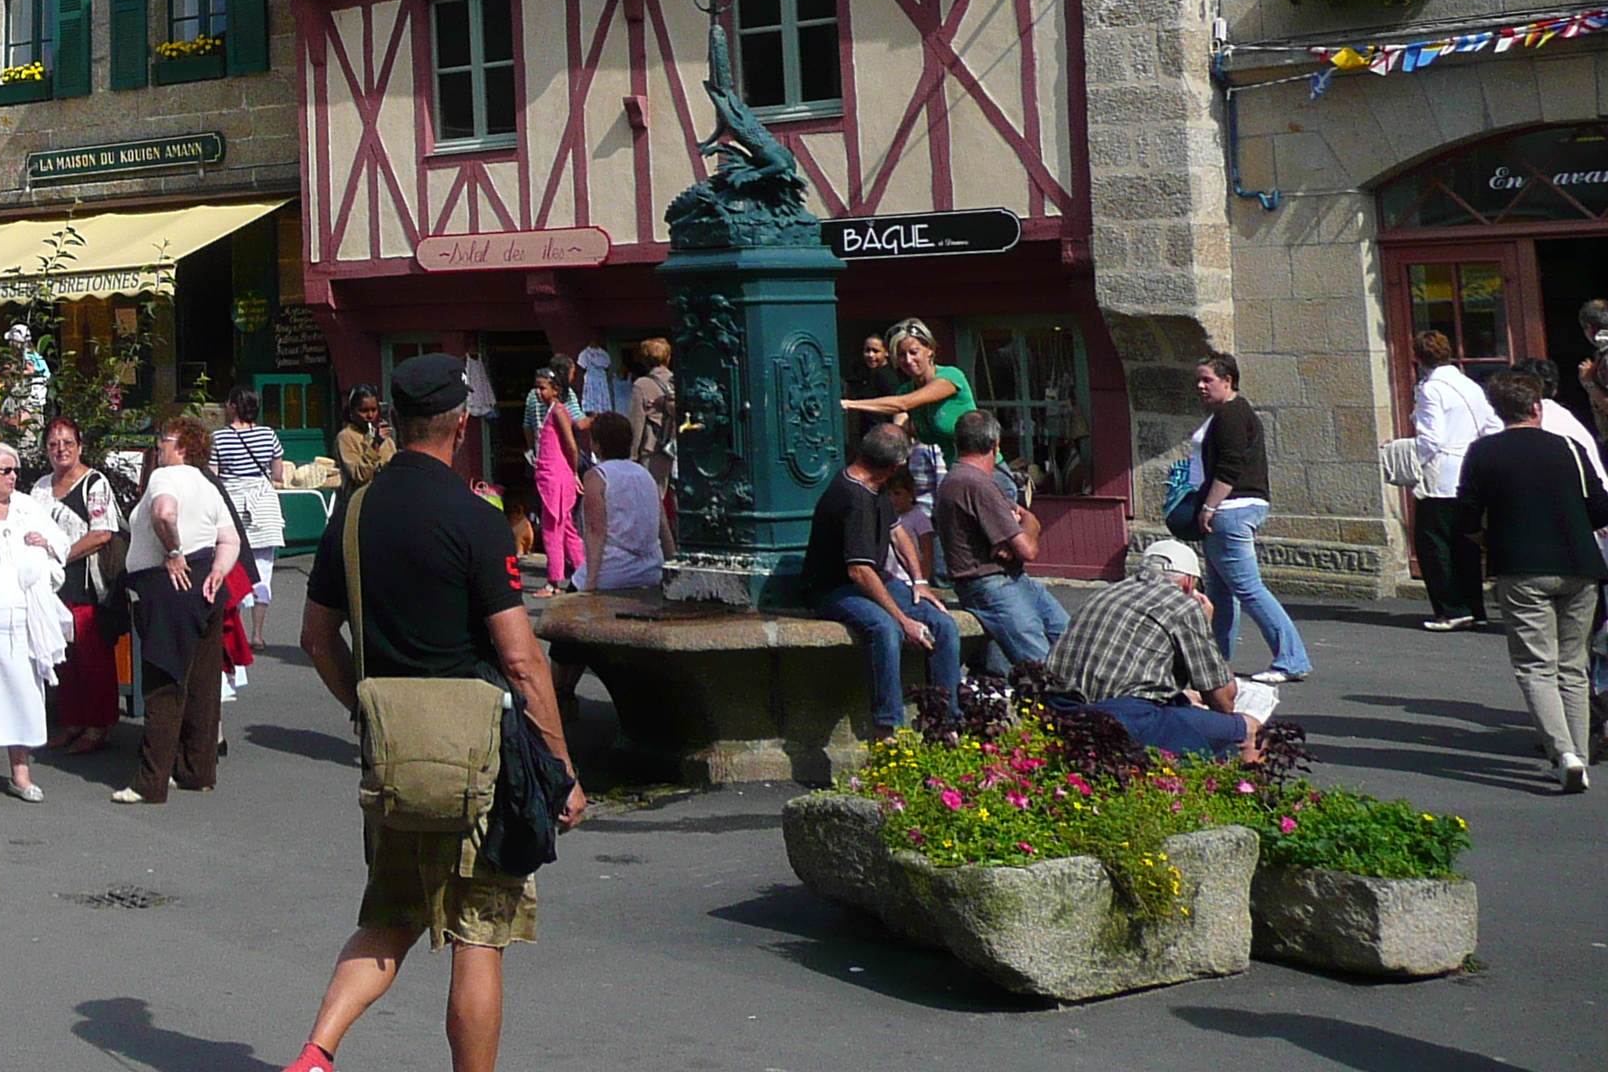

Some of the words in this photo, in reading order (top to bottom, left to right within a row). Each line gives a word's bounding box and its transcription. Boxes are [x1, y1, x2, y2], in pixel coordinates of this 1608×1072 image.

[39, 158, 54, 172] LA
[56, 154, 96, 171] MAISON
[100, 151, 115, 165] DU
[120, 146, 161, 163] KOUIGN
[164, 141, 203, 159] AMANN
[1489, 166, 1530, 190] En
[843, 223, 935, 255] BAGUE
[58, 272, 140, 295] BRETONNES
